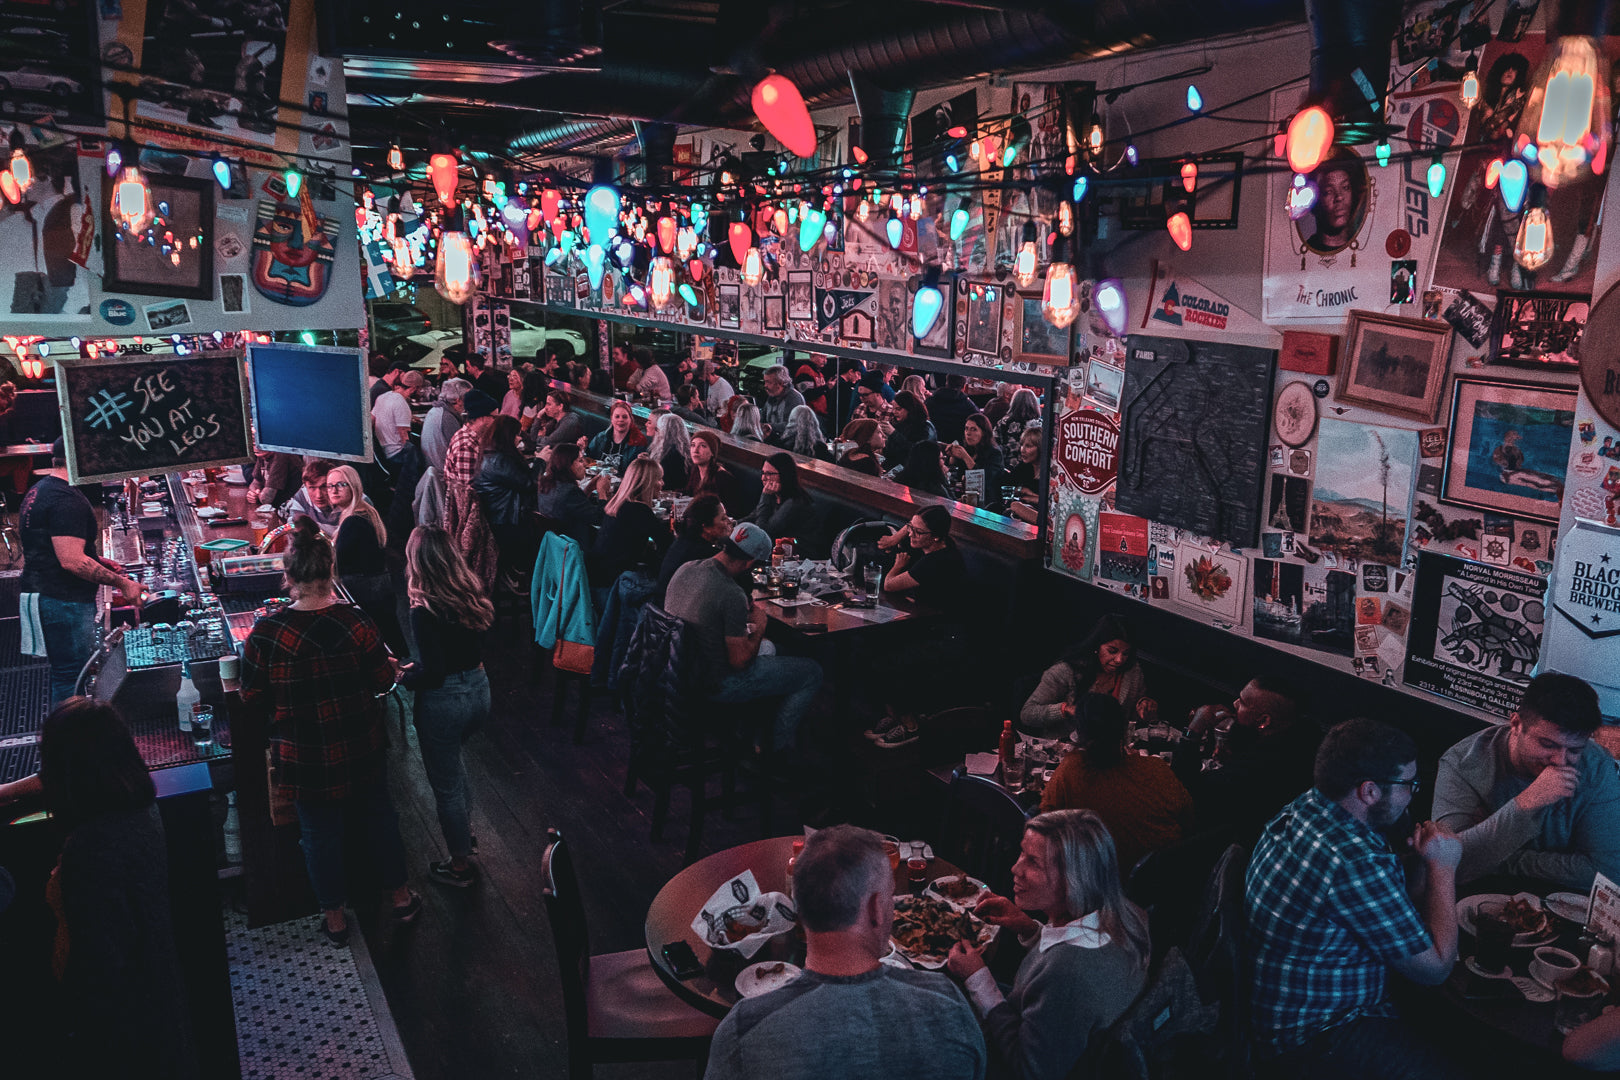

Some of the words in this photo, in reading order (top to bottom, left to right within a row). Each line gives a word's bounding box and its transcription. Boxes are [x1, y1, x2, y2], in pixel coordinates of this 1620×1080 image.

[1181, 294, 1230, 316] COLORADO
[1296, 284, 1313, 305] THE
[1315, 286, 1359, 307] CHRONIC
[1184, 308, 1228, 330] ROCKIES
[1135, 349, 1154, 361] PARIS
[119, 416, 165, 451] YOU
[168, 397, 193, 431] AT
[168, 413, 220, 457] LEO'S
[1063, 422, 1119, 450] SOUTHERN
[1065, 444, 1115, 470] COMFORT
[1463, 563, 1491, 576] NORVAL
[1492, 569, 1540, 587] MORRISSEAU
[1466, 572, 1489, 584] Legend
[1508, 581, 1523, 591] Own
[1574, 560, 1620, 585] BLAC
[1571, 577, 1620, 602] BRIDG
[1570, 591, 1620, 613] BREWER
[1419, 680, 1436, 691] 2312
[1443, 673, 1457, 683] May
[1457, 678, 1472, 688] 23rd
[1480, 685, 1496, 696] June
[1494, 681, 1506, 691] and
[1506, 684, 1525, 696] limite
[1488, 695, 1521, 711] GALLERY
